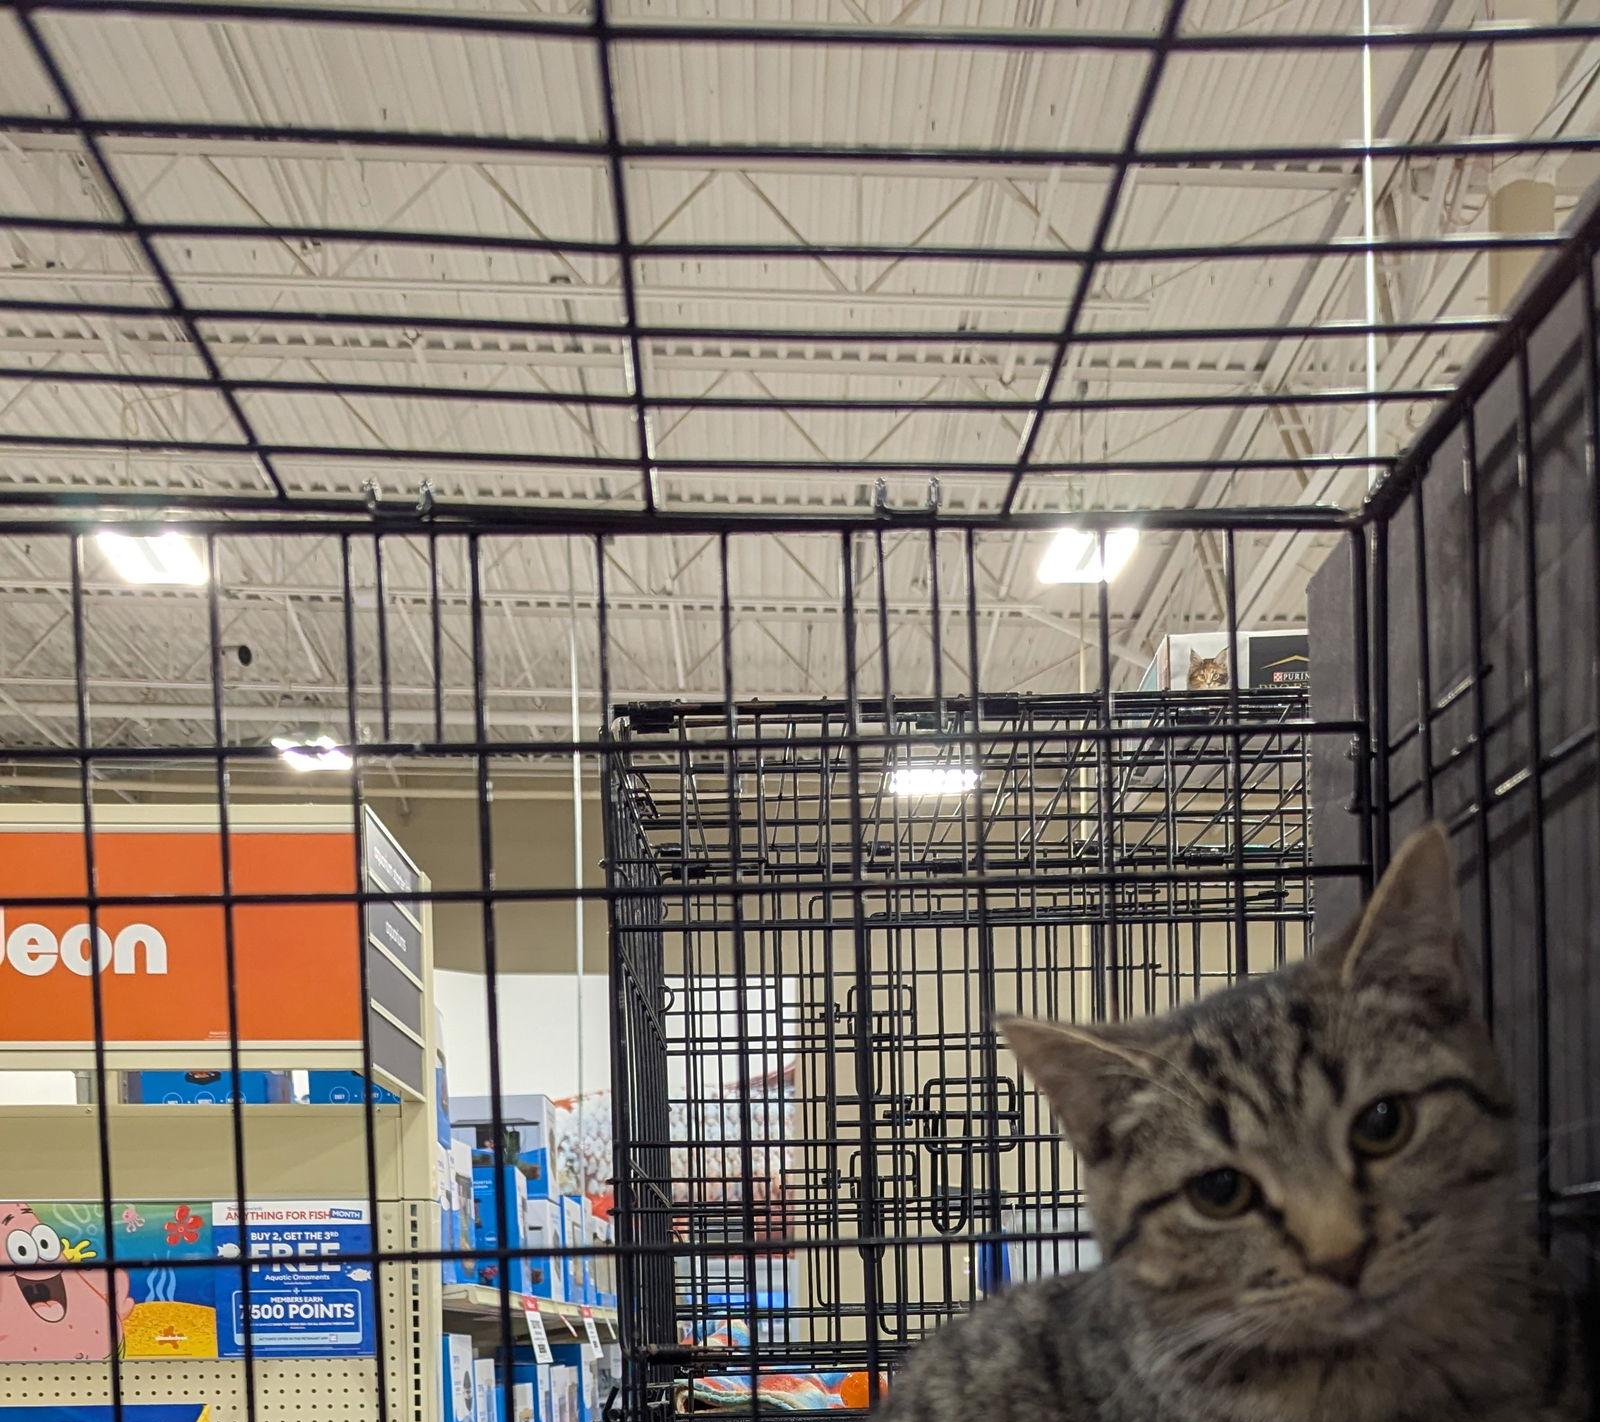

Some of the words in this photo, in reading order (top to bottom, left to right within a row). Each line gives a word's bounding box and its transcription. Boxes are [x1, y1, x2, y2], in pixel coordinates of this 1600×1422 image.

[0, 907, 168, 976] eon
[286, 1210, 306, 1221] FOR
[309, 1210, 331, 1221] FISH
[331, 1209, 361, 1219] MONTH
[250, 1231, 271, 1241] BUY
[272, 1231, 282, 1242] 2,
[283, 1231, 302, 1241] GET
[304, 1231, 323, 1241] THE
[250, 1242, 341, 1273] FREE
[264, 1274, 292, 1282] Aquatic
[288, 1303, 355, 1319] POINTS
